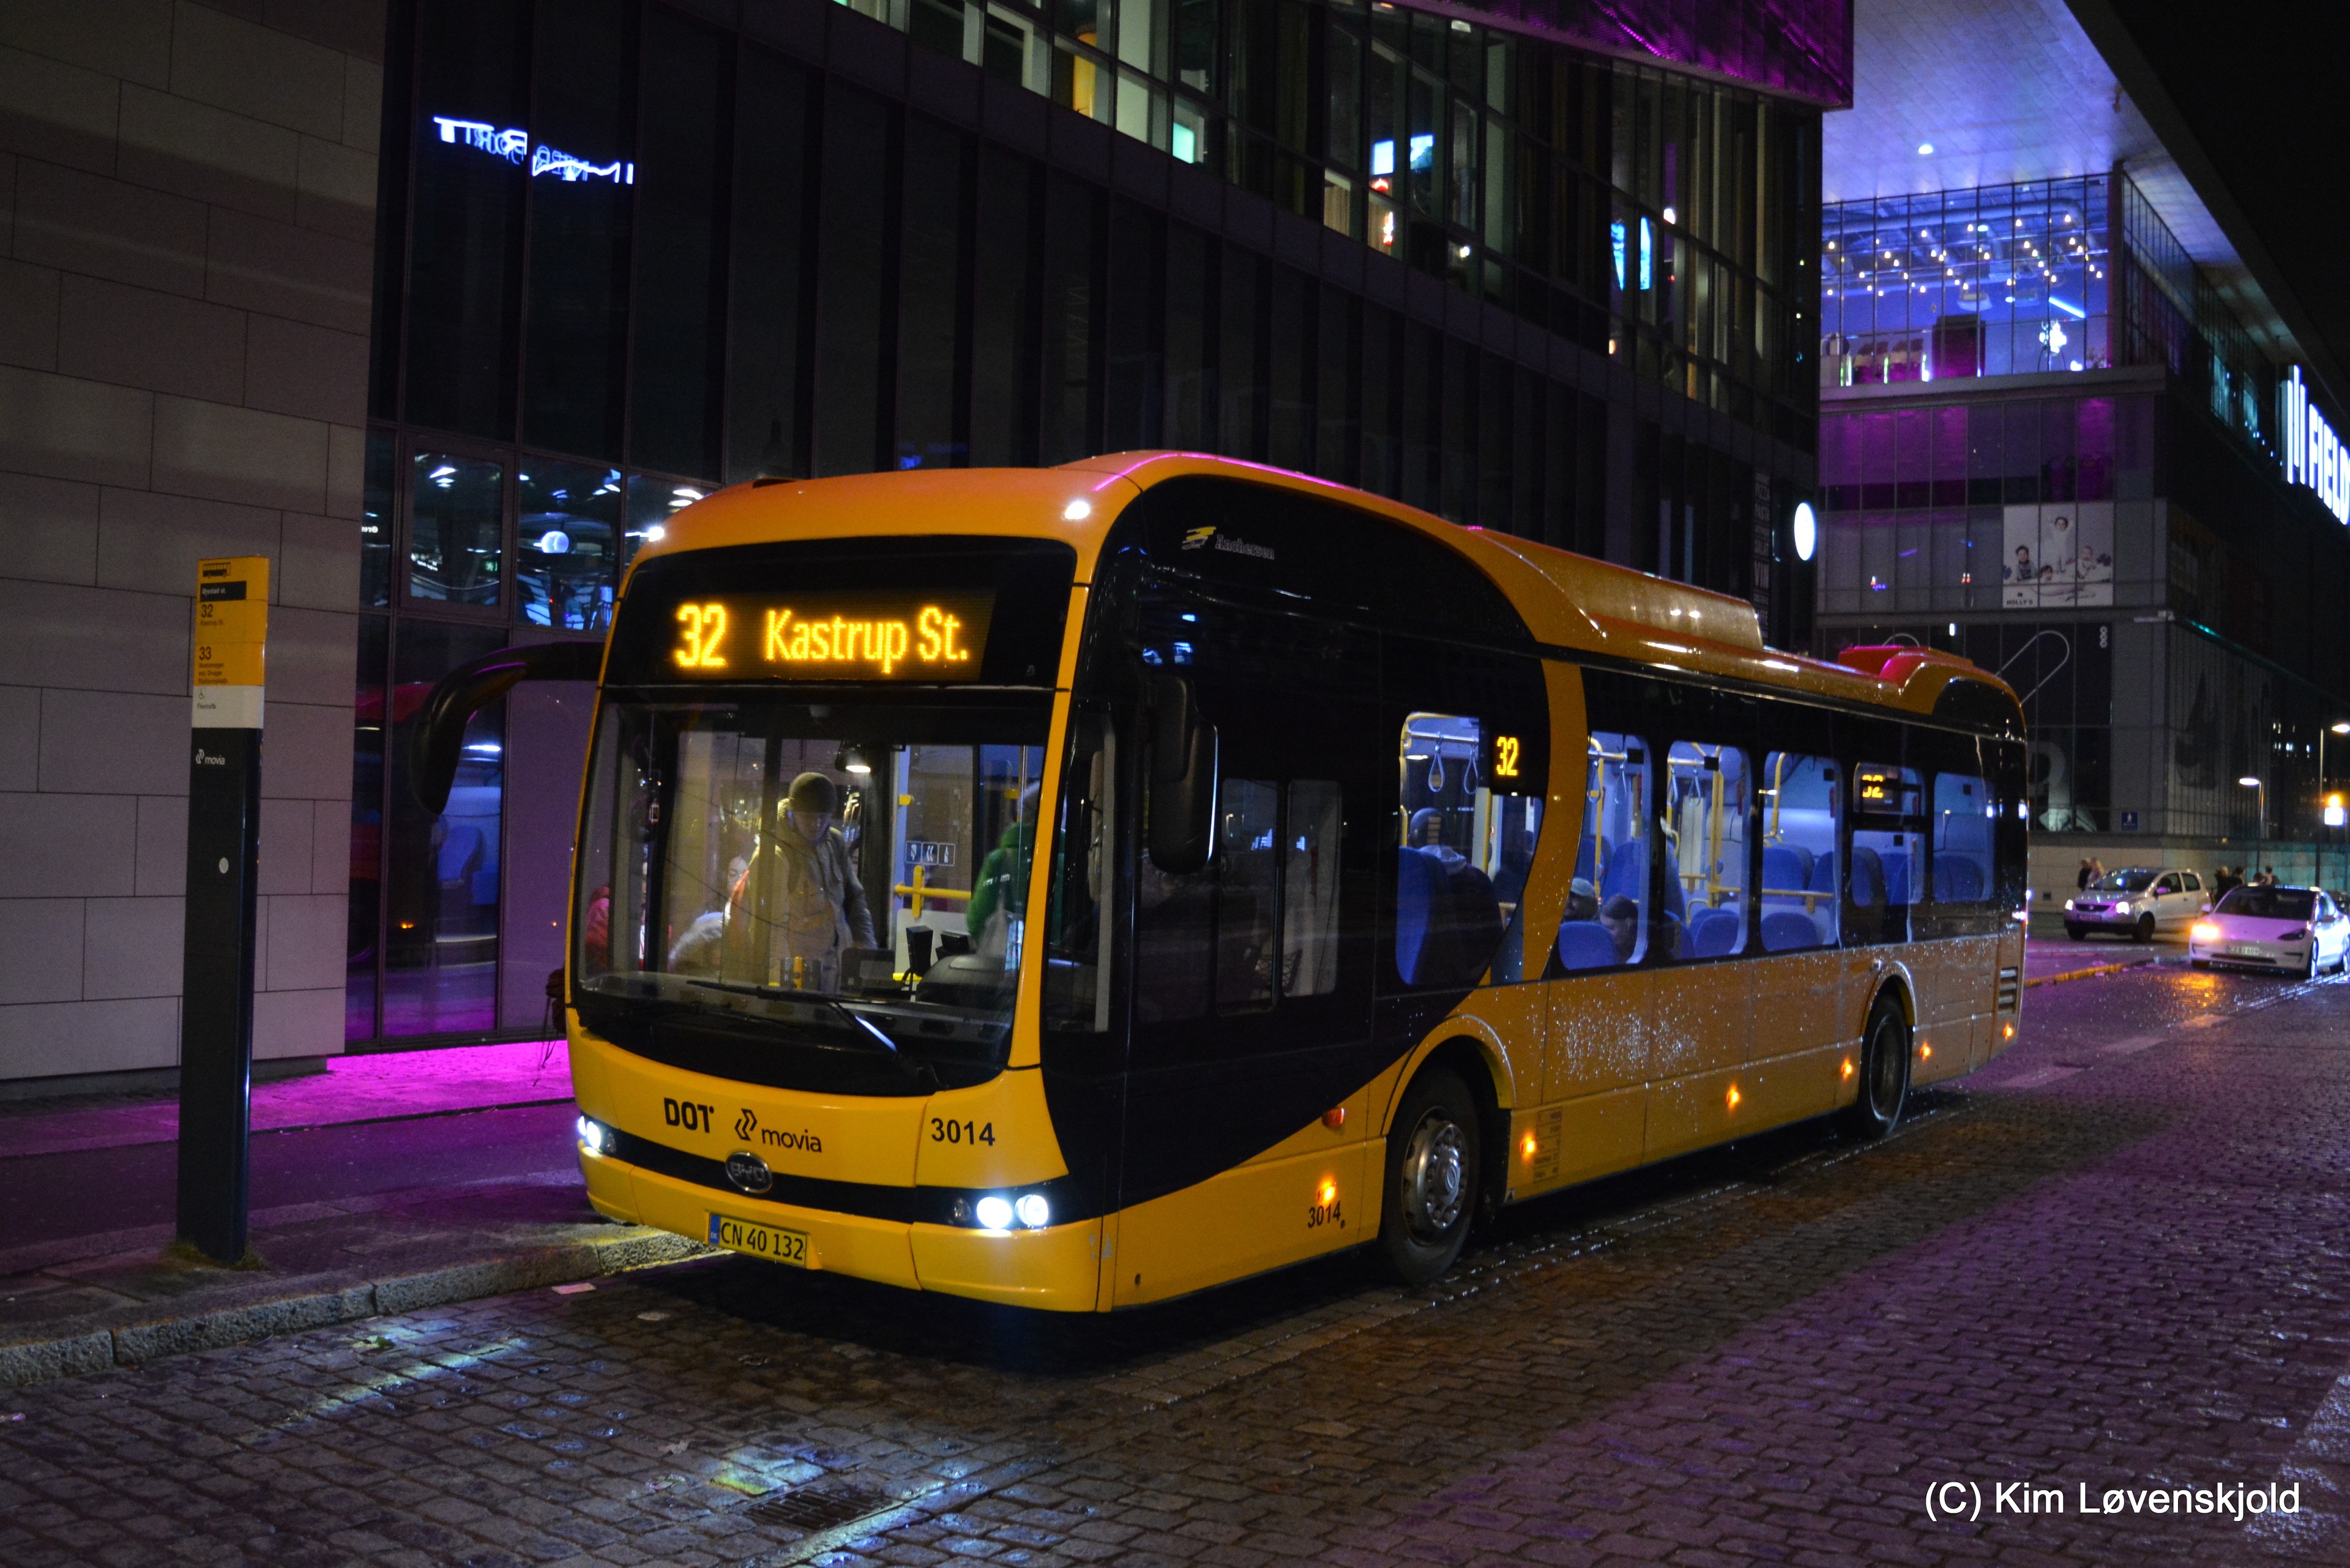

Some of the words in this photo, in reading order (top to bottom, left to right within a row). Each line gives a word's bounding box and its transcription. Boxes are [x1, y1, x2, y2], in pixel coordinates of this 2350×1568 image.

[2309, 403, 2350, 525] FIELD
[1215, 534, 1275, 560] Anchersen
[201, 604, 213, 618] 32
[199, 646, 211, 660] 33
[676, 605, 727, 666] 32
[765, 610, 907, 673] Kastrup
[918, 607, 969, 662] St.
[205, 755, 225, 765] movia
[1496, 736, 1518, 775] 32
[664, 1097, 714, 1133] DOT
[761, 1129, 822, 1152] movia
[931, 1118, 995, 1146] 3014
[730, 1162, 765, 1182] BYD
[1308, 1200, 1340, 1228] 3014
[722, 1222, 742, 1246] CN
[747, 1228, 767, 1252] 40
[774, 1234, 803, 1260] 132
